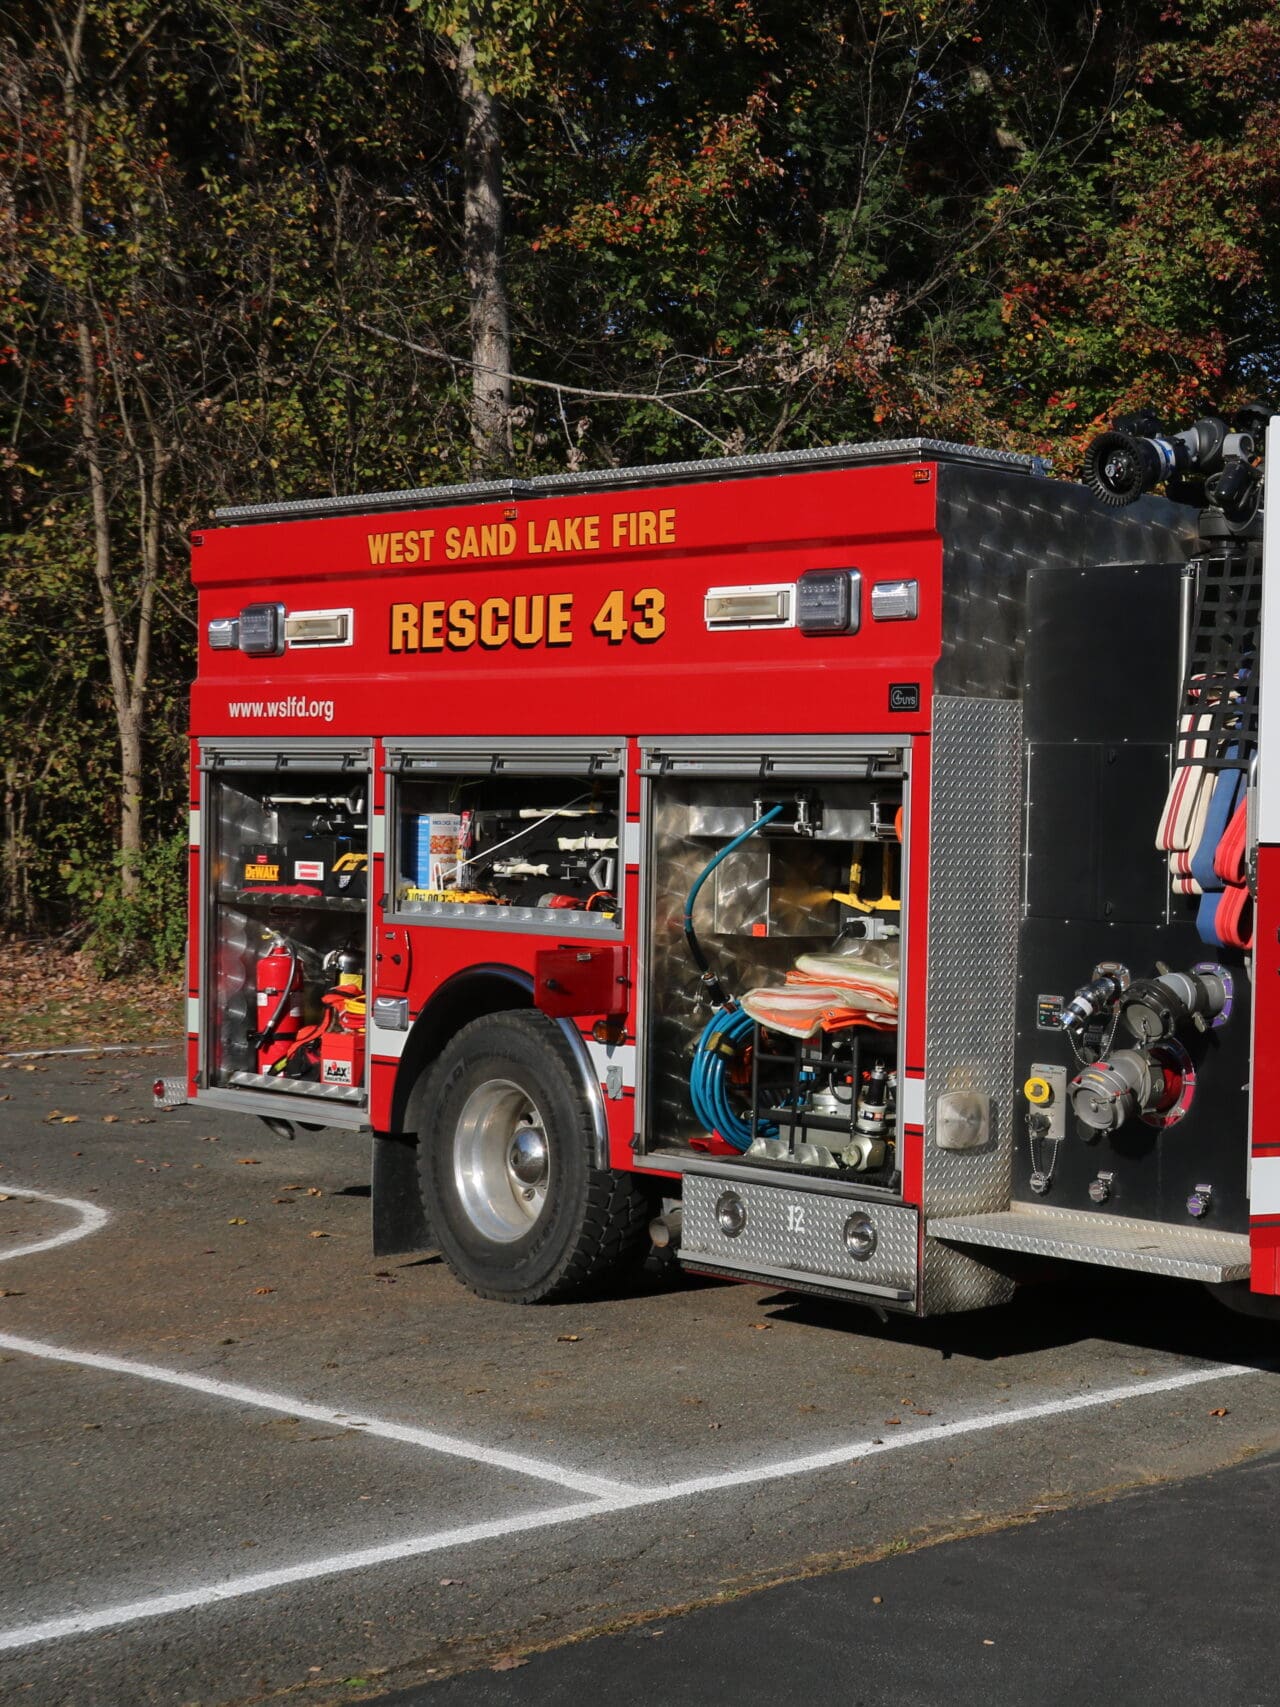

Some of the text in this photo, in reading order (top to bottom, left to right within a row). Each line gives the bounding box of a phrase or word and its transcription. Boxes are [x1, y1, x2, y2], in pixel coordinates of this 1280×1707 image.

[368, 509, 676, 565] WEST SAND LAKE FIRE
[390, 588, 666, 654] RESCUE 43
[228, 696, 334, 722] www.wslfd.org
